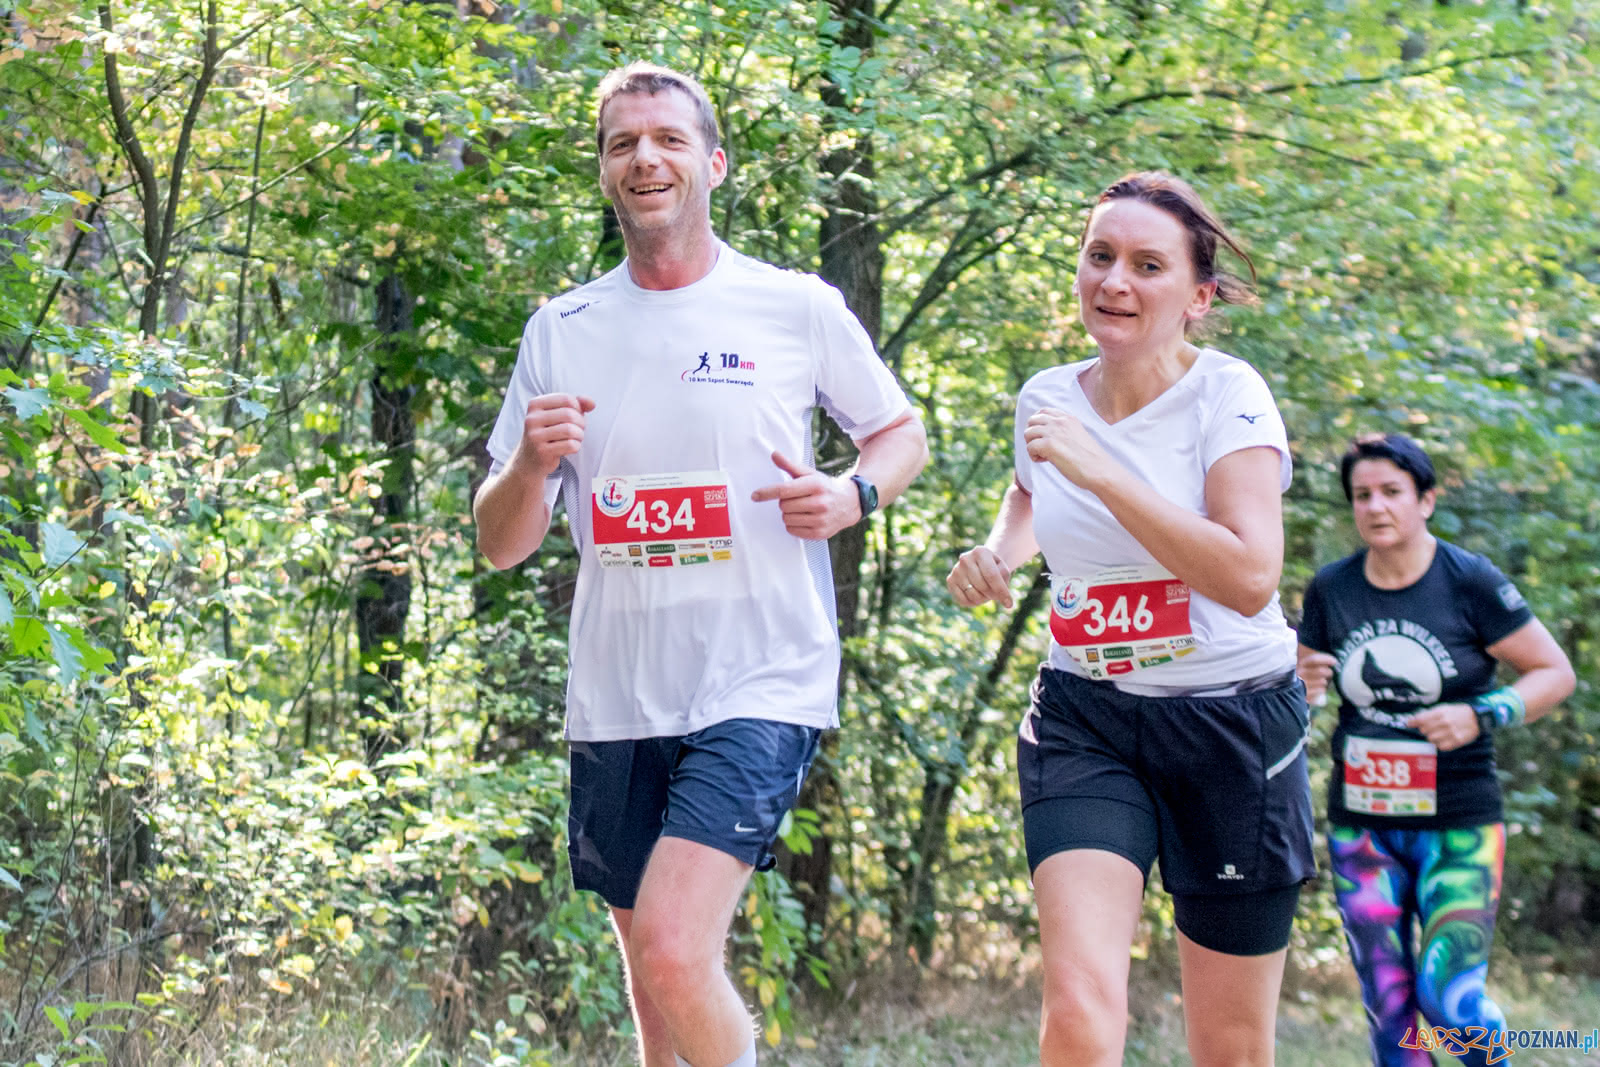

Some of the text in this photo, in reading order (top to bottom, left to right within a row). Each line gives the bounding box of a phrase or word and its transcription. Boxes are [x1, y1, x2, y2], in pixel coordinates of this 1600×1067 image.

[720, 352, 739, 369] 10
[626, 498, 695, 535] 434
[1083, 595, 1154, 637] 346
[1374, 618, 1399, 636] ZA
[1362, 757, 1411, 786] 338
